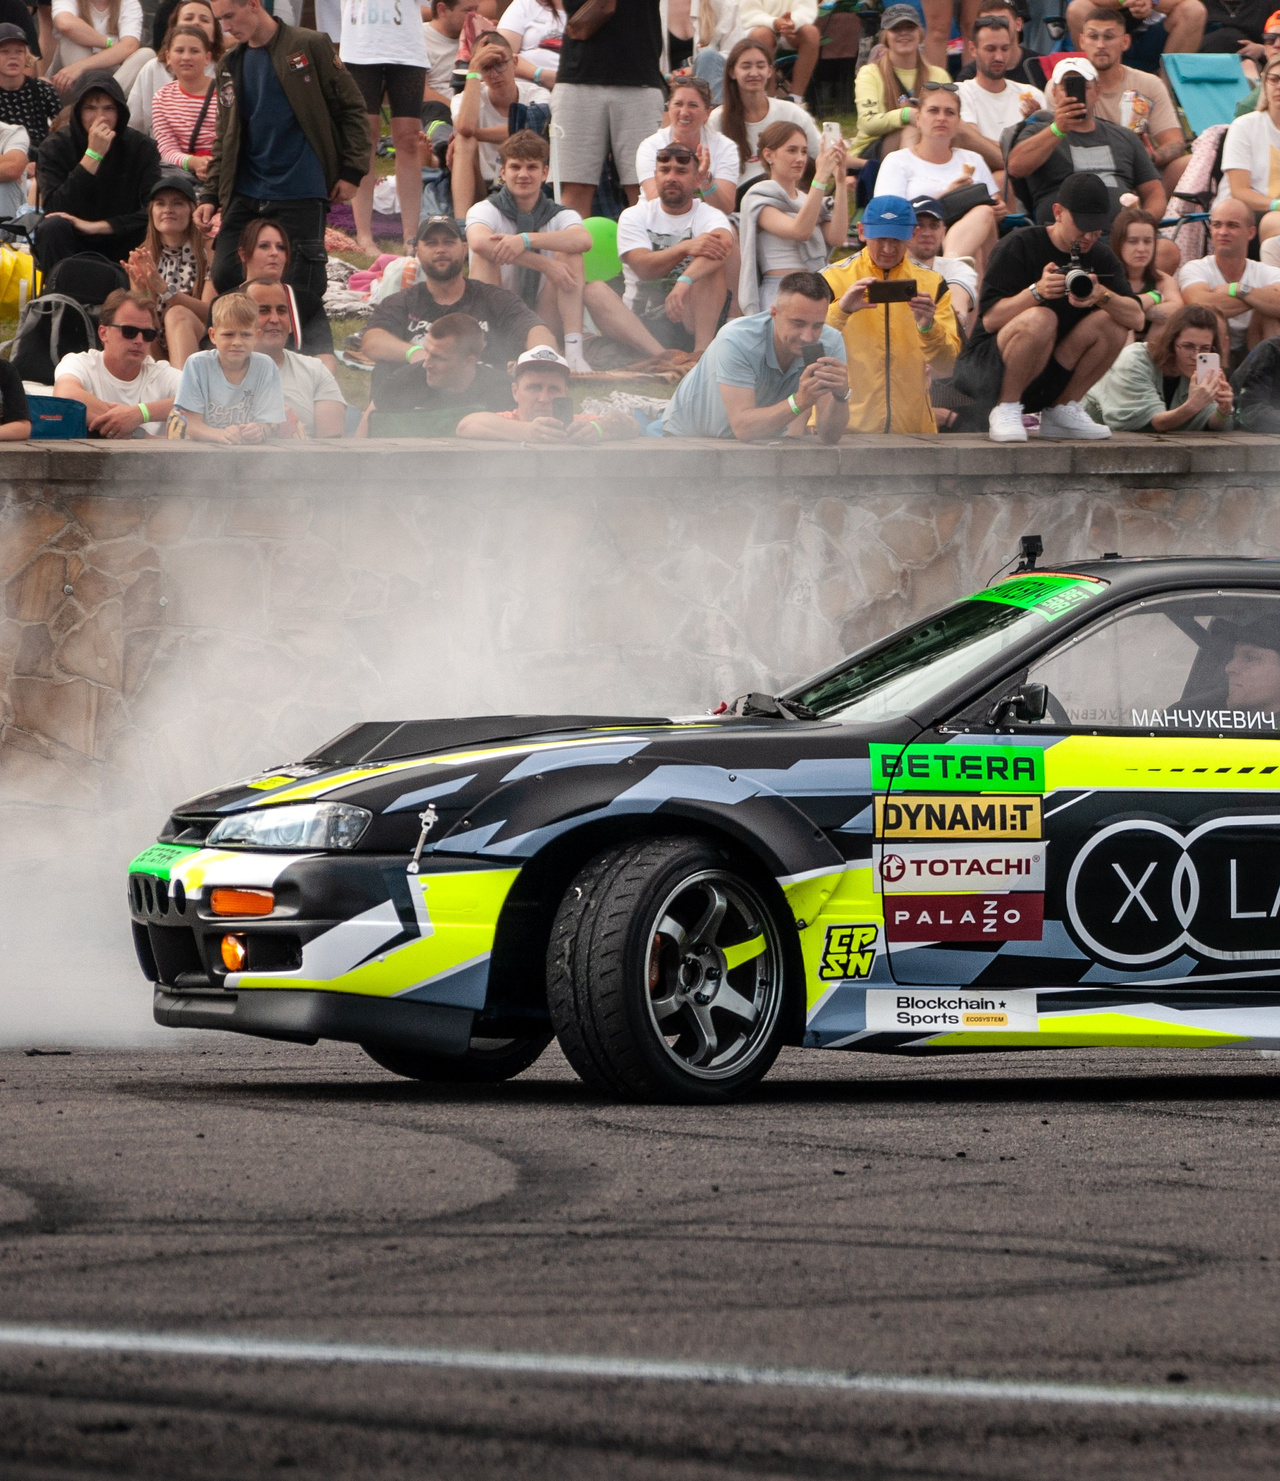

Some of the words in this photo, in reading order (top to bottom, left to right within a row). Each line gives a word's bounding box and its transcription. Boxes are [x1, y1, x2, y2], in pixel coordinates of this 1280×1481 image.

[1131, 708, 1276, 730] МАНЧУКЕВИЧ
[894, 900, 1021, 933] PALAZZO
[896, 996, 995, 1010] Blockchain
[896, 1011, 959, 1026] Sports
